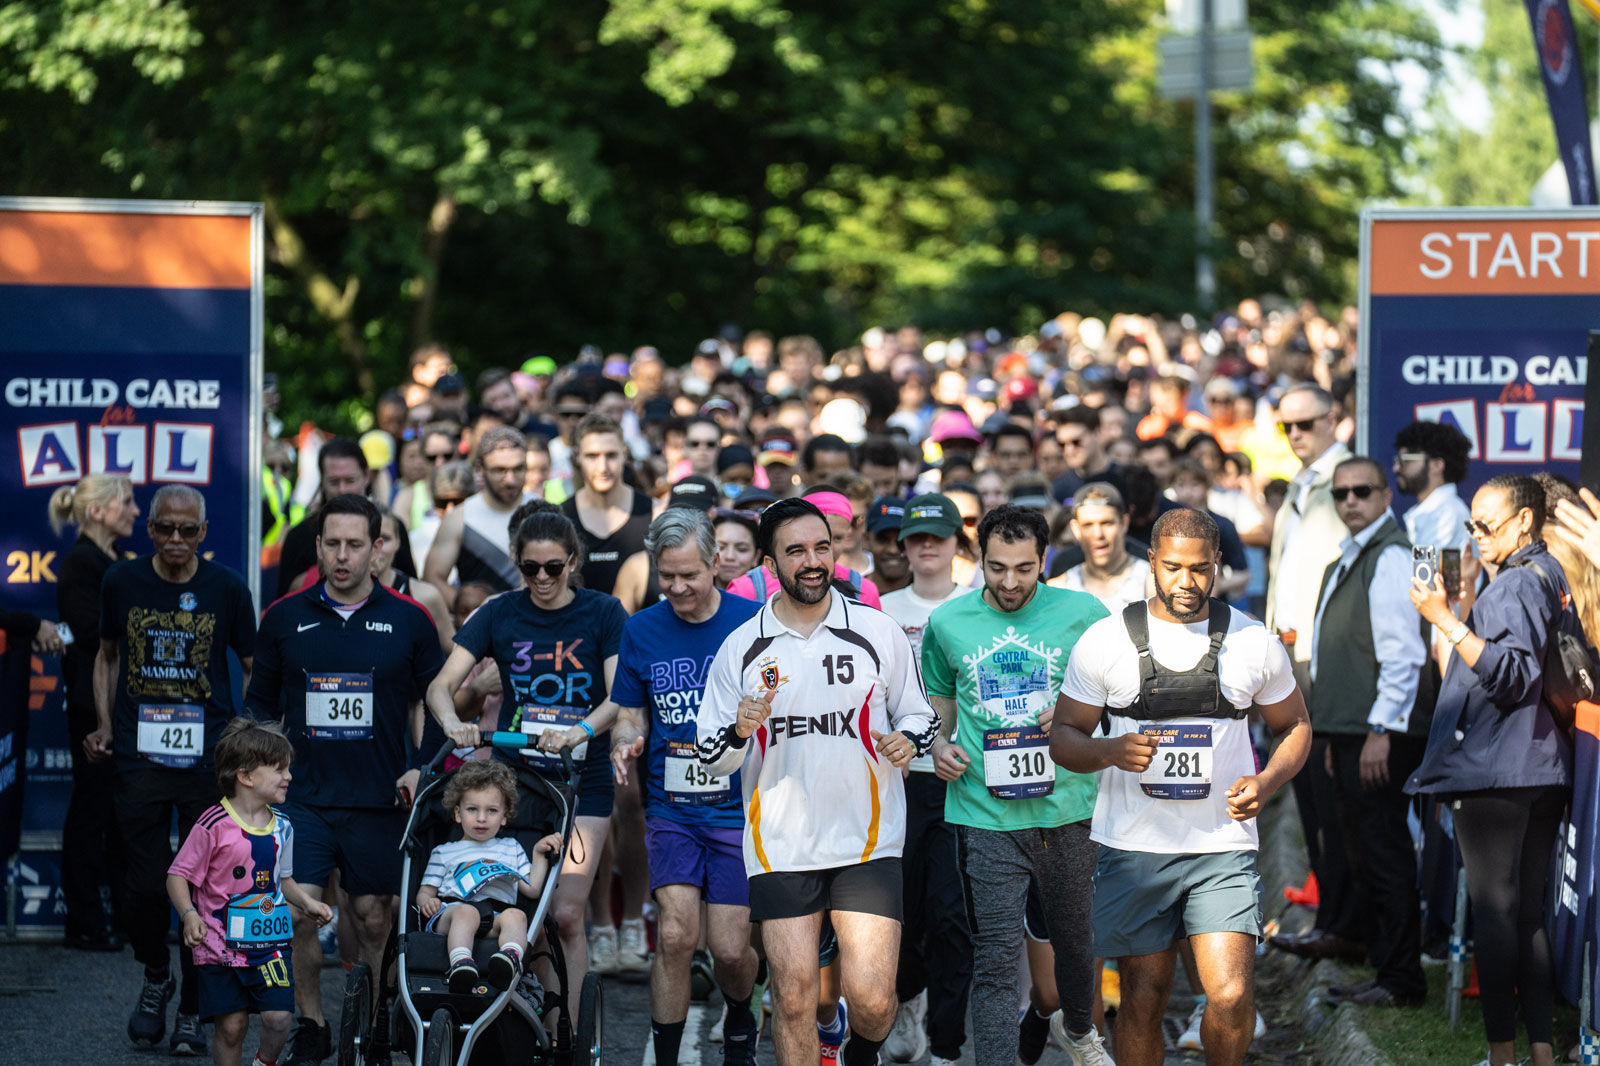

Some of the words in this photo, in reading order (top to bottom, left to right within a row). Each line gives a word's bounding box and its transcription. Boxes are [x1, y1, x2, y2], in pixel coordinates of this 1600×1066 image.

[1419, 232, 1600, 279] START
[1402, 355, 1519, 385] CHILD
[4, 377, 119, 407] CHILD
[125, 379, 220, 409] CARE
[100, 402, 135, 428] for
[30, 429, 198, 476] ALL
[6, 551, 57, 583] 2K
[147, 629, 195, 640] MANHATTAN
[365, 621, 392, 633] USA
[511, 638, 584, 672] 3-K
[992, 651, 1030, 663] CENTRAL
[1001, 662, 1024, 674] PARK
[141, 665, 197, 680] MAMDANI
[822, 654, 855, 685] 15
[509, 672, 593, 704] FOR
[328, 698, 363, 720] 346
[658, 707, 701, 725] SIGA
[1004, 697, 1028, 710] HALF
[160, 727, 194, 749] 421
[768, 707, 859, 748] FENIX
[1008, 751, 1046, 779] 310
[1164, 752, 1202, 778] 281
[250, 916, 289, 936] 6806
